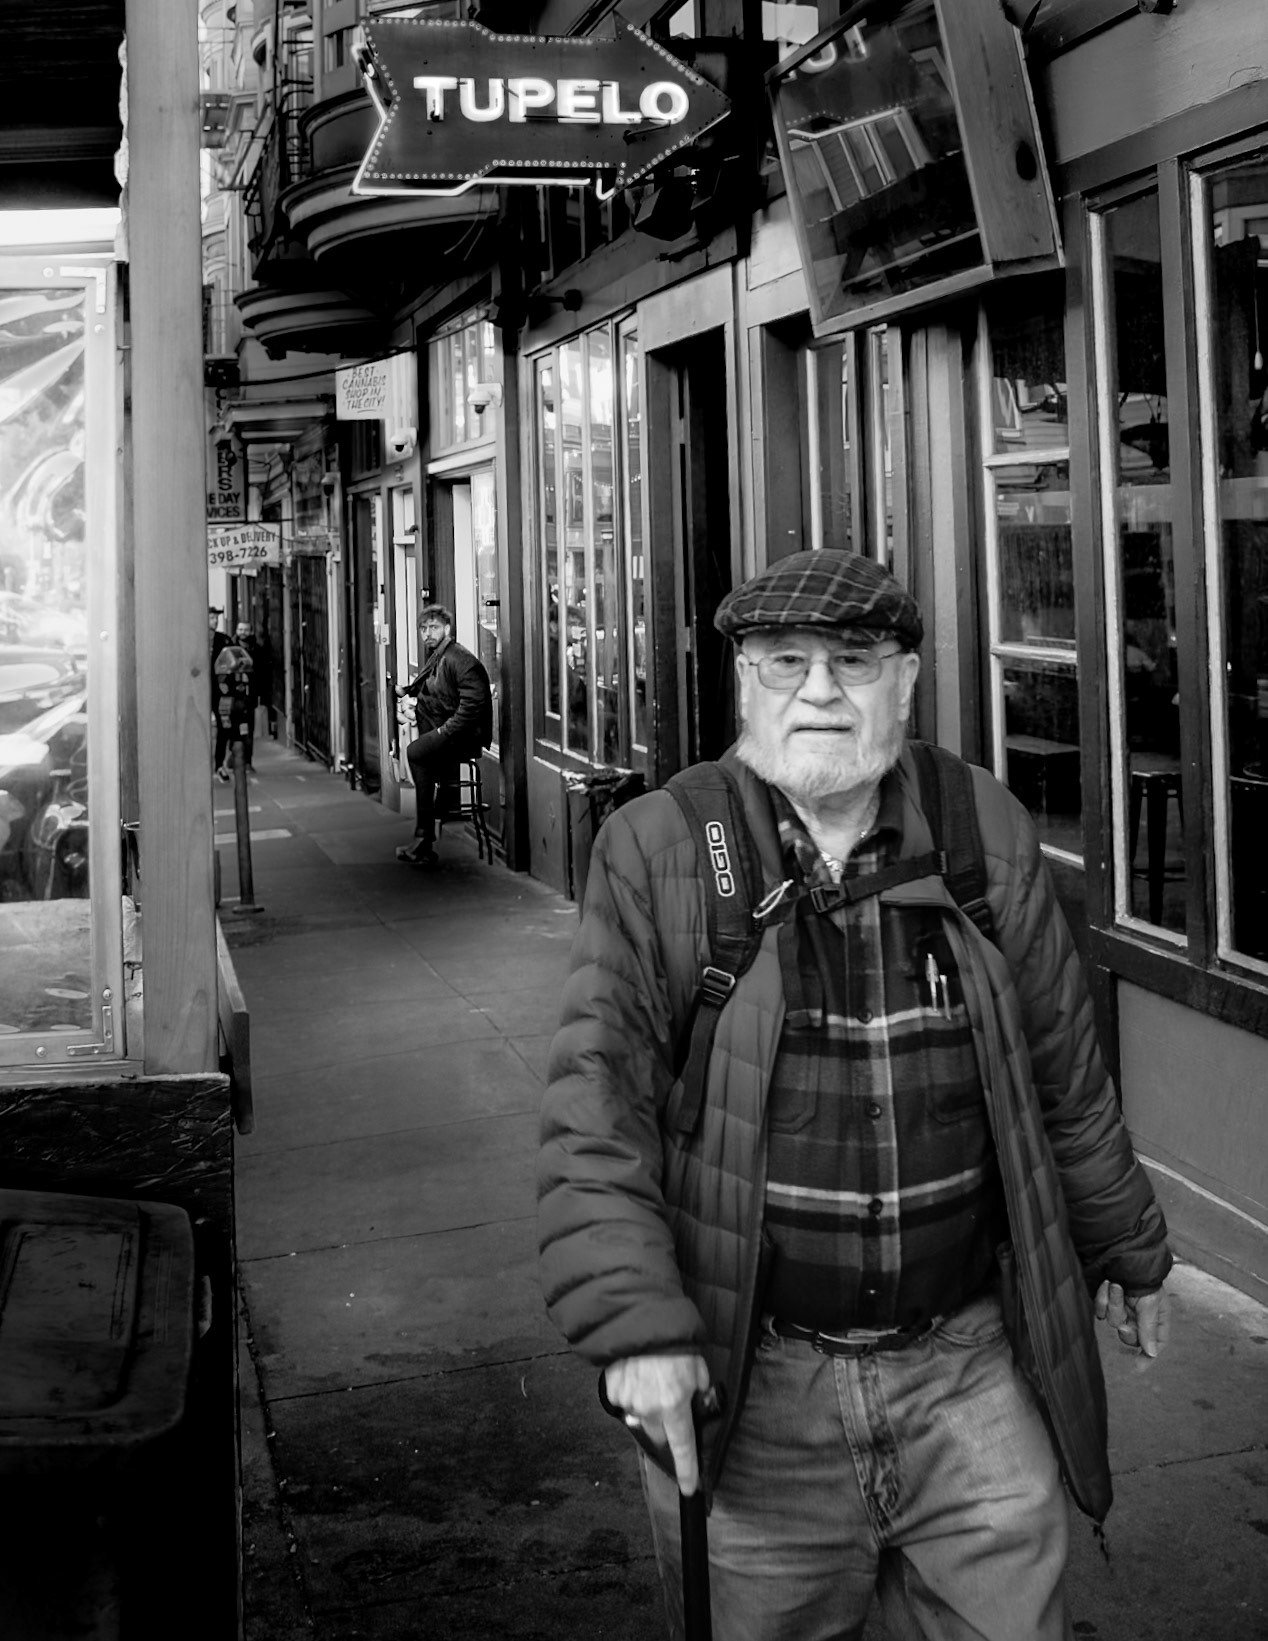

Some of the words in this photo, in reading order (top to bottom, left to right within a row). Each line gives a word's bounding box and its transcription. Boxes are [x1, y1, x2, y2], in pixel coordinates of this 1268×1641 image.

[413, 76, 689, 125] TUPELO
[352, 366, 375, 379] BEST
[342, 375, 386, 390] CANNABIS
[345, 387, 368, 399] SHOP
[370, 386, 381, 397] IN
[347, 398, 362, 410] THE
[363, 395, 386, 408] CITY!
[218, 492, 240, 504] DAY
[220, 535, 231, 547] UP
[233, 536, 239, 545] &
[241, 531, 276, 544] DELIVERY
[209, 545, 268, 564] 398-7226
[705, 821, 735, 897] OGIO
